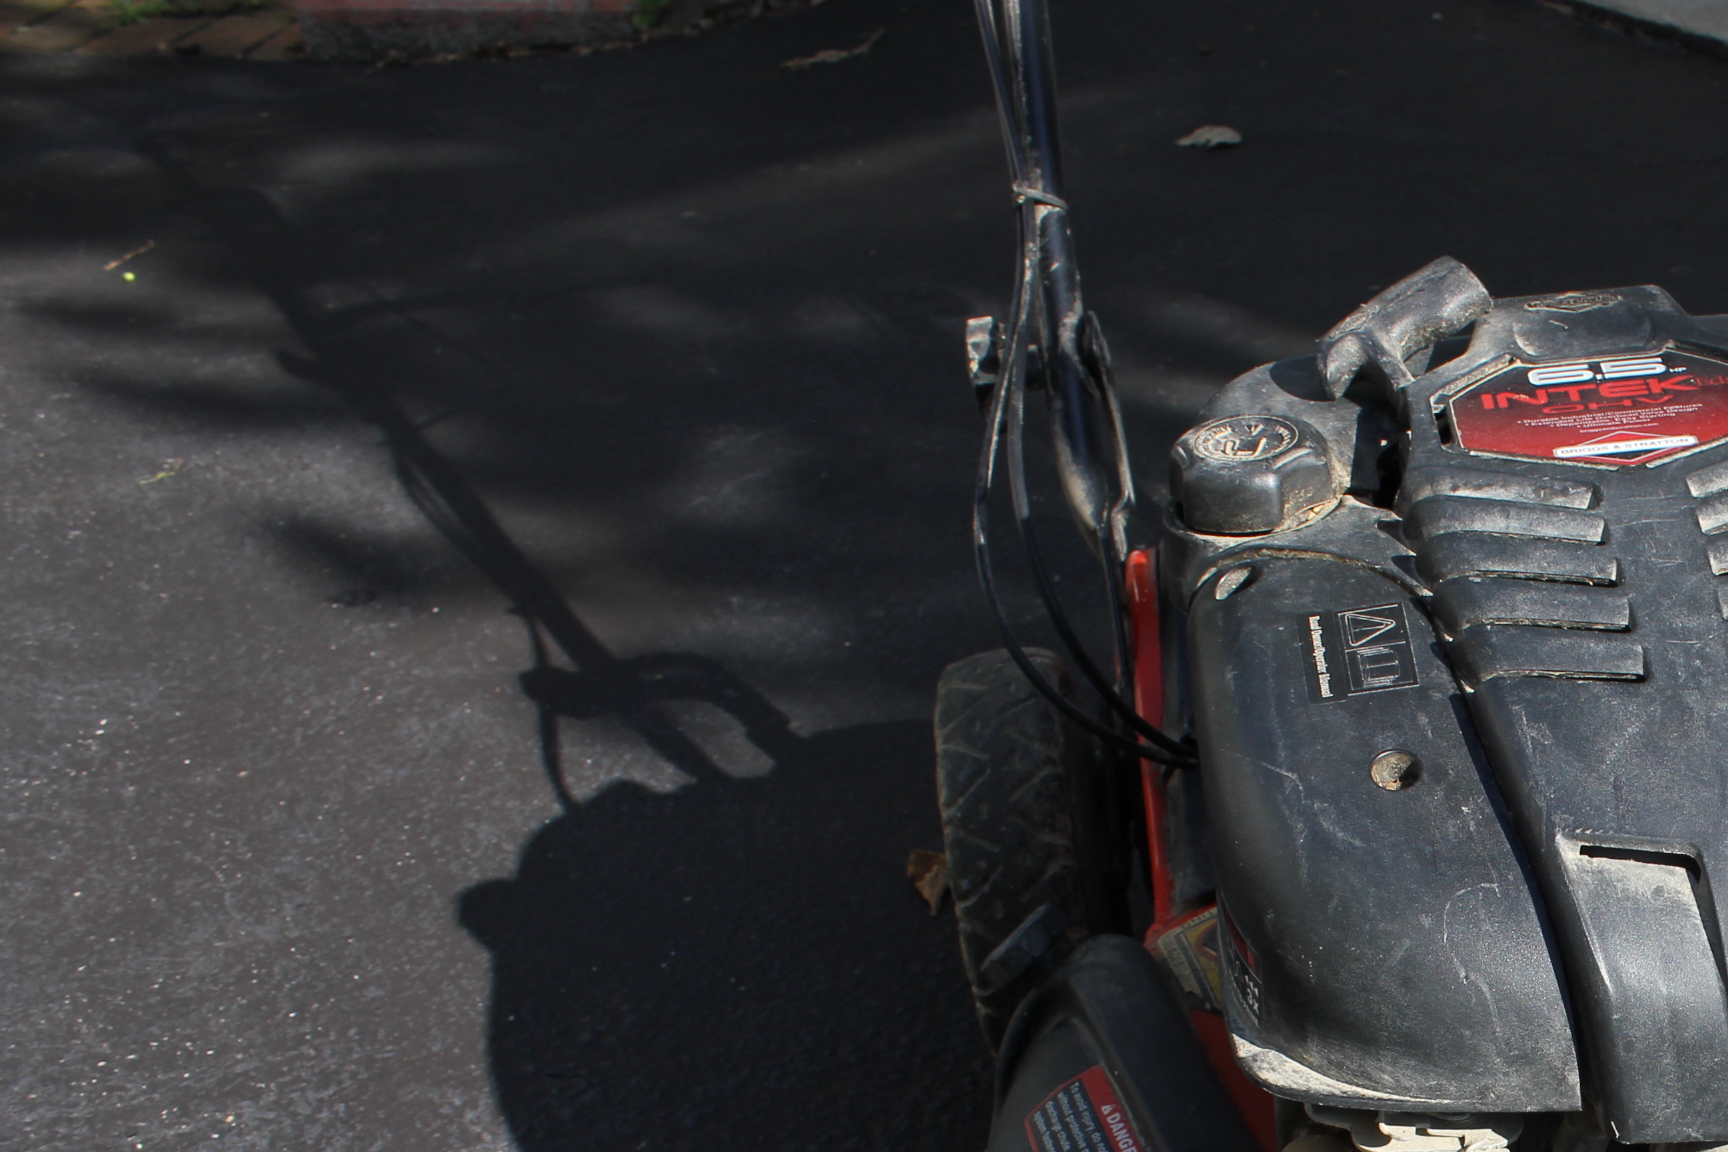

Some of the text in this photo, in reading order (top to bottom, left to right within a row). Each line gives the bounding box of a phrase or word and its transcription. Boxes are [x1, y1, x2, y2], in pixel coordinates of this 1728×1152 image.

[1527, 357, 1667, 386] 6.5
[1481, 374, 1699, 410] INTEK
[1542, 395, 1674, 414] OHV
[1595, 412, 1638, 420] Overhead
[1561, 445, 1608, 455] BRIGGS
[1625, 437, 1689, 449] STRATTON
[1309, 616, 1322, 629] Read
[1319, 673, 1333, 697] Manual
[1070, 1083, 1081, 1093] To
[1075, 1092, 1088, 1110] avoid
[1033, 1111, 1047, 1134] system
[1043, 1102, 1063, 1132] discharge
[1057, 1092, 1073, 1115] without
[1065, 1115, 1087, 1149] protective
[1091, 1131, 1103, 1143] do
